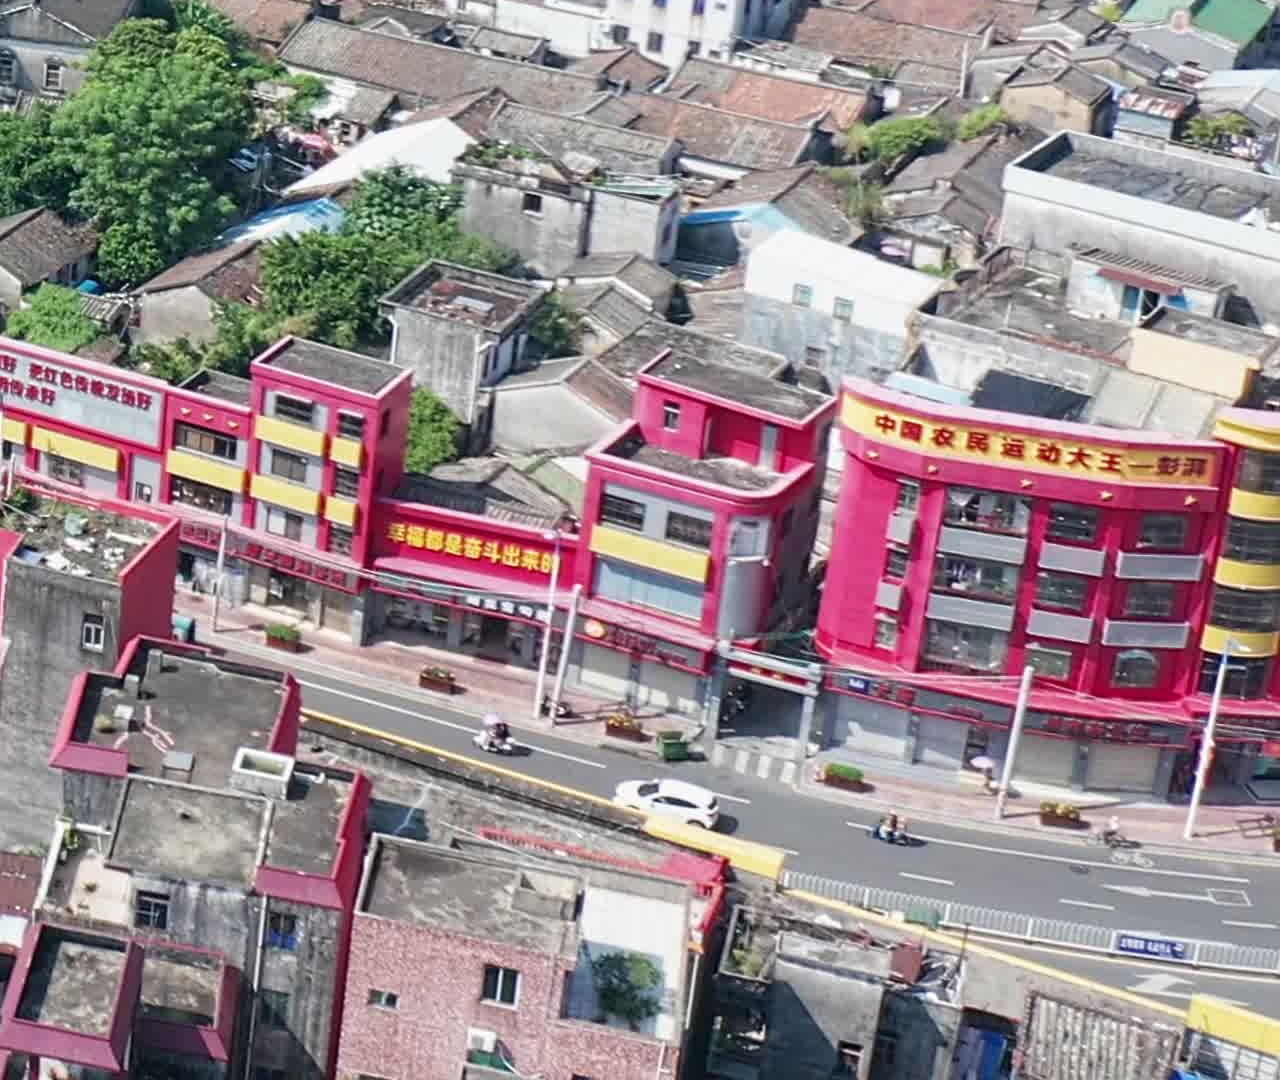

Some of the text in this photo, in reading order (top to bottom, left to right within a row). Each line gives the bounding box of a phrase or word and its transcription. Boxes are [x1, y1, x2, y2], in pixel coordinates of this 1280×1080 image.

[29, 362, 153, 410] 把红色传统发扬好
